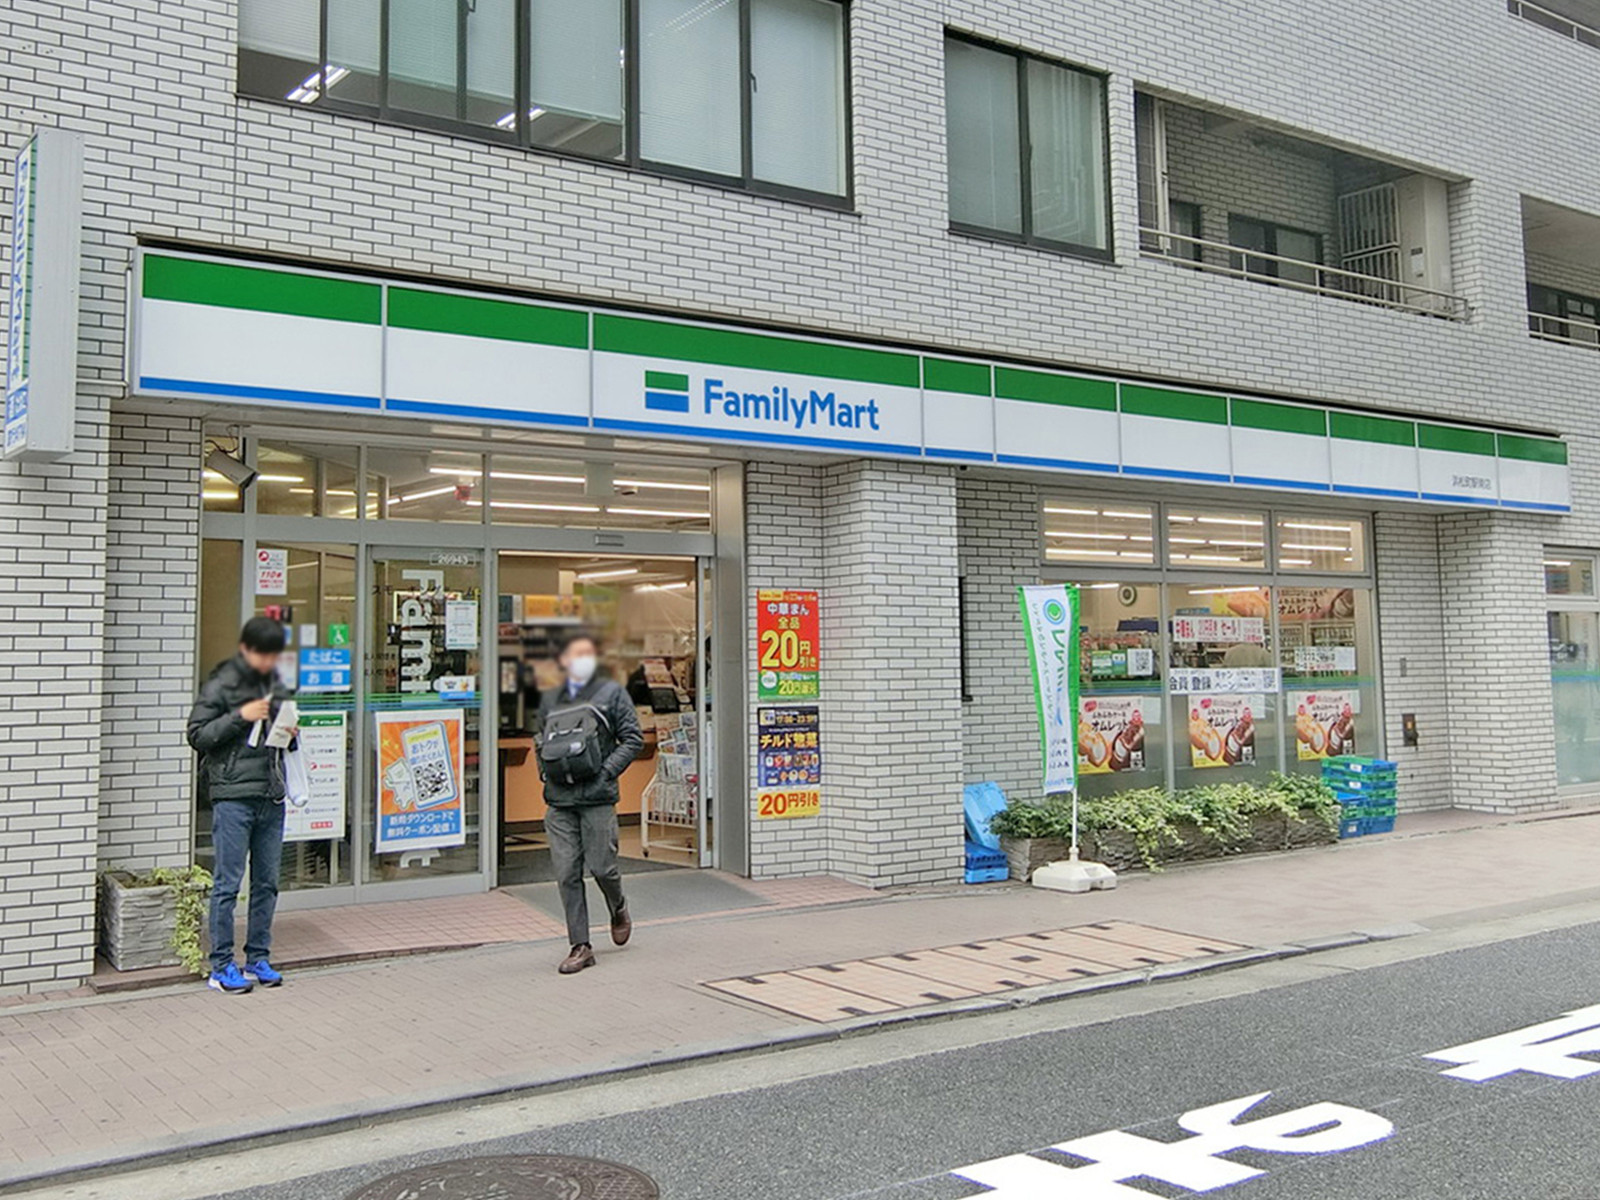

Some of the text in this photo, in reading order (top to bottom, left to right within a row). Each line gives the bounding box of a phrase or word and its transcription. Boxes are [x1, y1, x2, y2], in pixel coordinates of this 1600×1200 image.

[704, 378, 879, 430] FamilyMart
[438, 554, 468, 565] 26943
[767, 602, 809, 615] 中華まん
[1279, 605, 1322, 615] オムレット
[778, 617, 800, 629] 全品
[309, 651, 343, 663] たばこ
[1192, 676, 1211, 691] 登録
[760, 732, 818, 749] チルド惣菜
[760, 792, 819, 815] 20円引き
